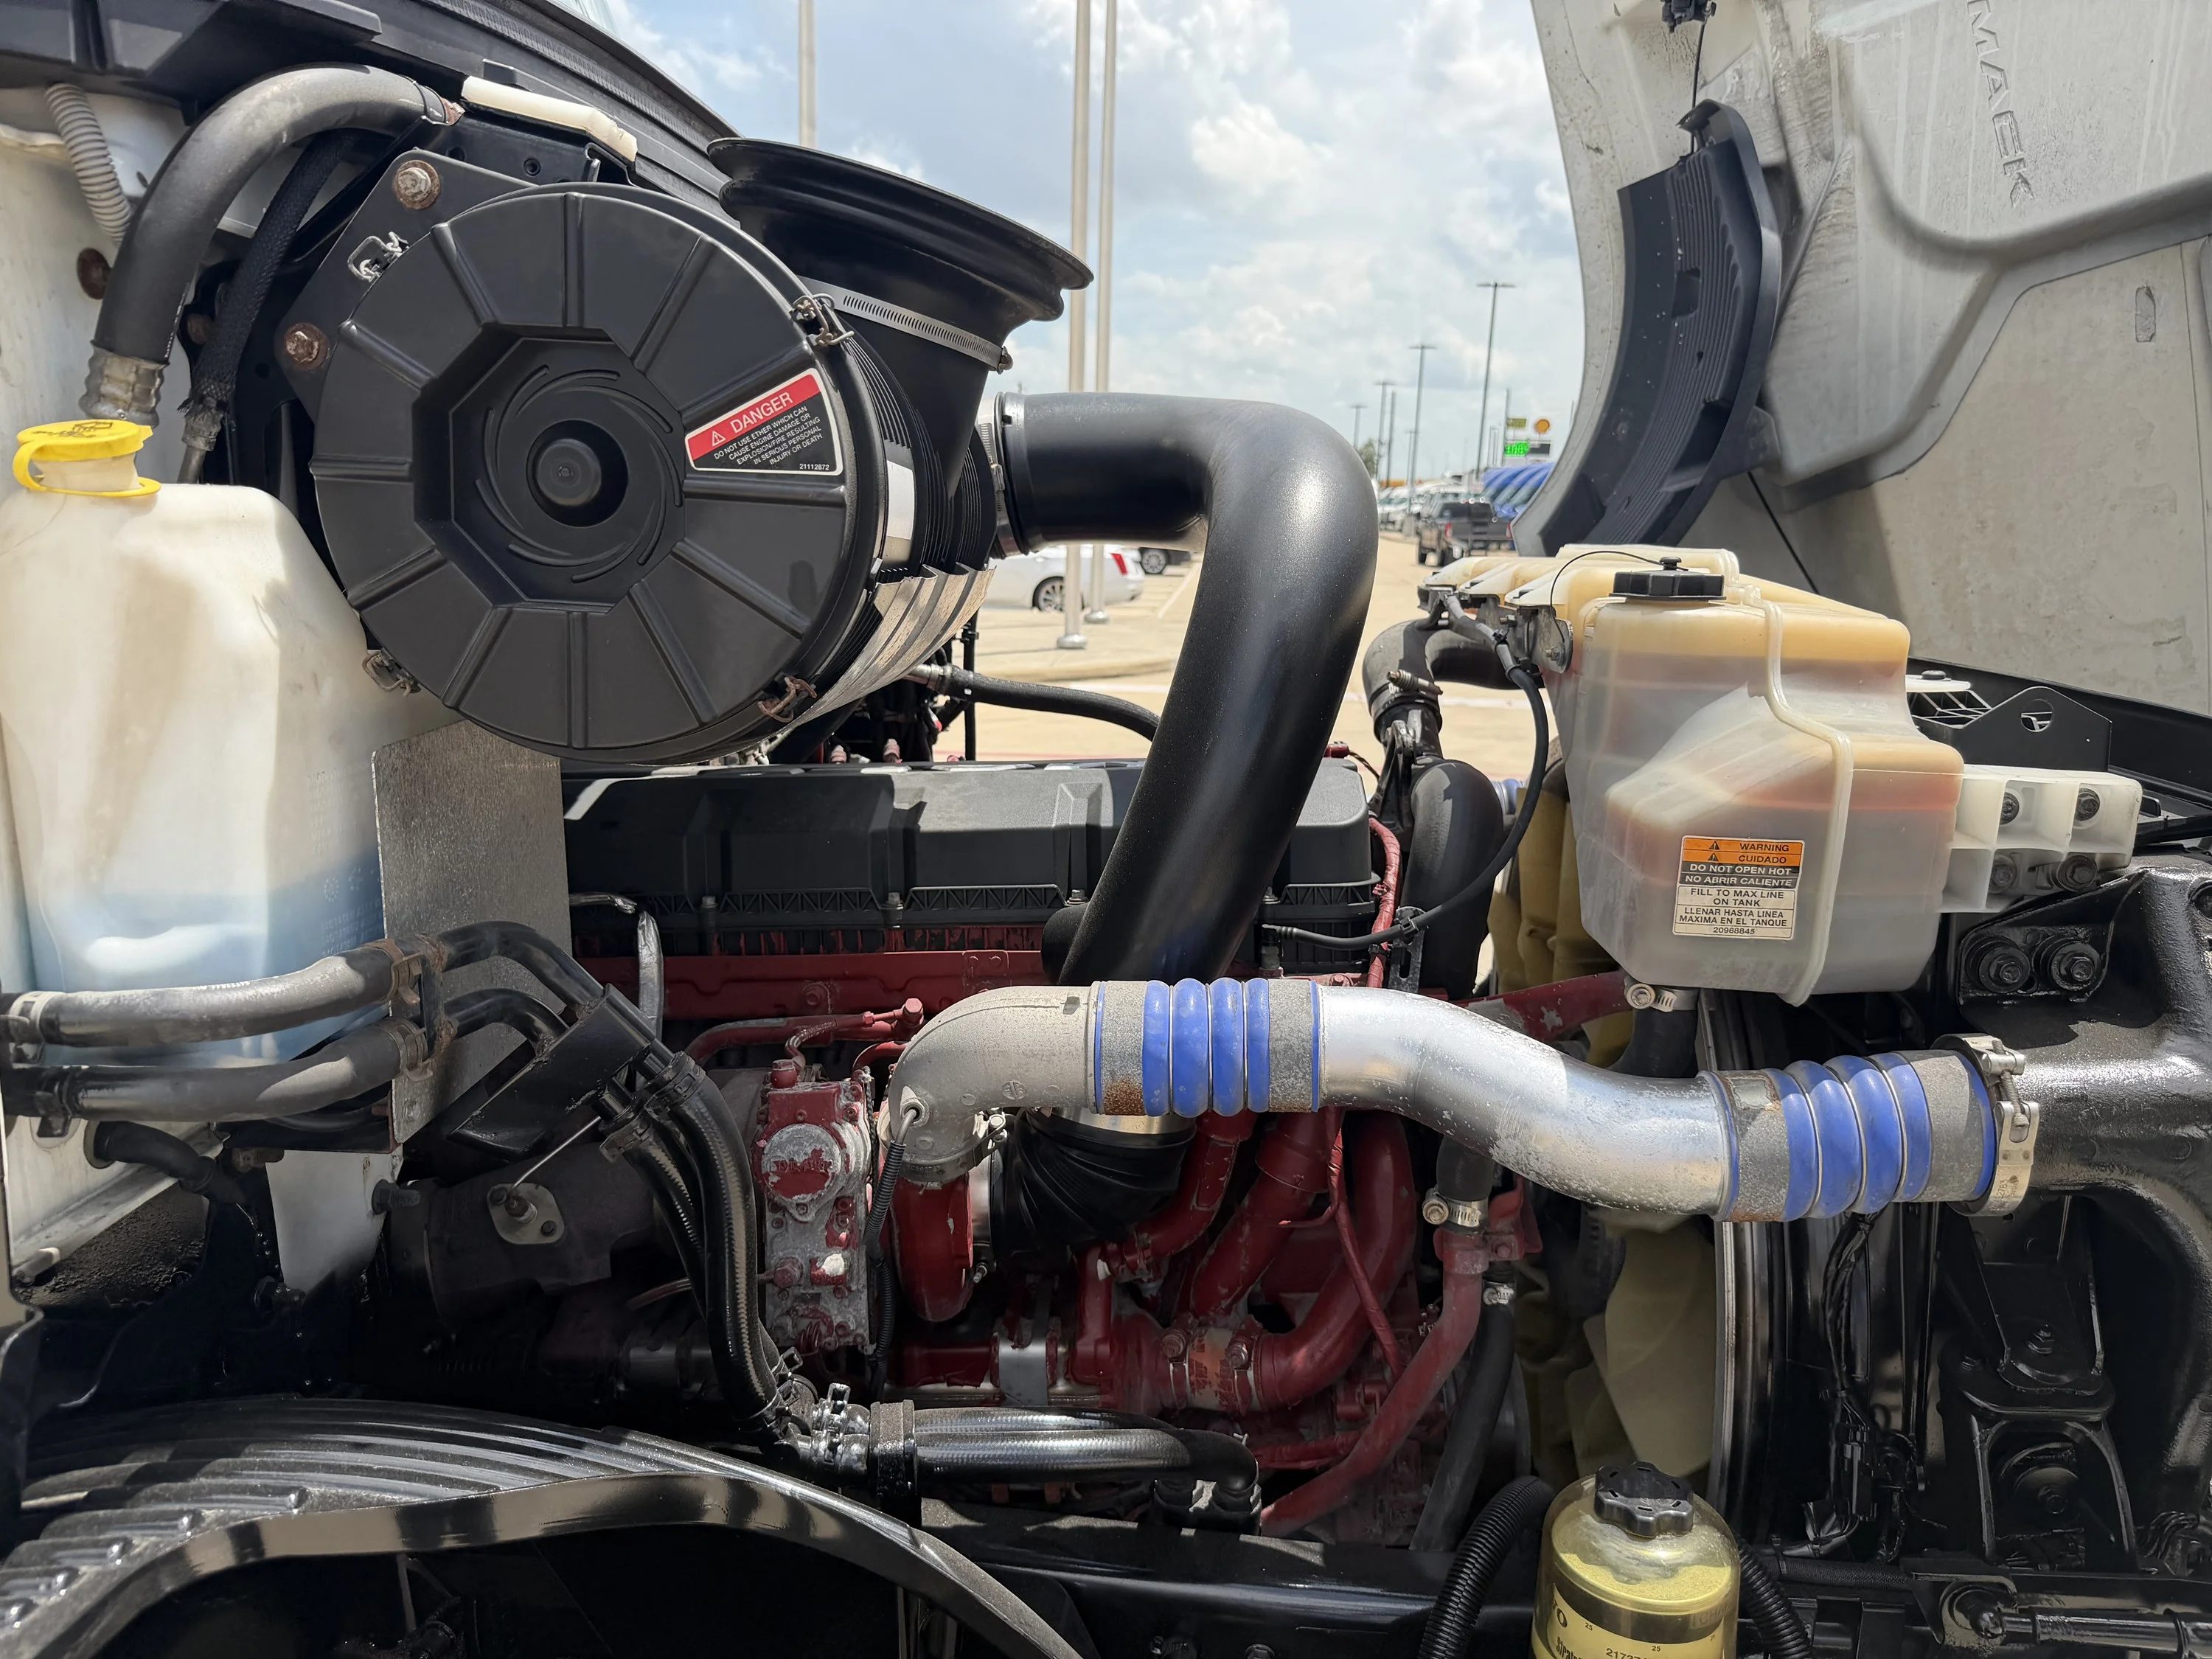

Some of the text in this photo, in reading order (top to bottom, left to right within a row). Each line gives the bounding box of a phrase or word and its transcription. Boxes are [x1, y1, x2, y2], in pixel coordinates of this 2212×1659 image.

[1966, 0, 2034, 207] MACK
[730, 392, 794, 434] DANGER
[714, 406, 807, 459] DO NOT USE ETHER WHICH CAN
[728, 413, 811, 460] CAUSE ENGINE DAMAGE OR
[737, 417, 821, 465] EXPLOSION/FIRE RESULTING
[753, 425, 822, 465] IN SERIOUS PERSONAL
[769, 433, 824, 465] INJURY OR DEATH
[1739, 843, 1790, 852] WARNING
[1738, 855, 1787, 864] CUIDADO
[1709, 865, 1733, 873] NOT
[1735, 866, 1765, 874] OPEN
[1768, 867, 1792, 875] HOT
[1703, 876, 1737, 885] ABRIR
[1740, 877, 1792, 886] CALIENTE
[1691, 888, 1713, 896] FILL
[1733, 890, 1757, 898] MAX
[1760, 891, 1784, 899] LINE
[1732, 899, 1761, 907] TANK
[1684, 907, 1784, 918] LLENAR HASTA LINEA
[1679, 915, 1787, 927] MAXIMA EN EL TANQUE
[1713, 927, 1756, 935] 20968845
[1585, 1622, 1593, 1631] 25
[1556, 1636, 1582, 1659] Strat
